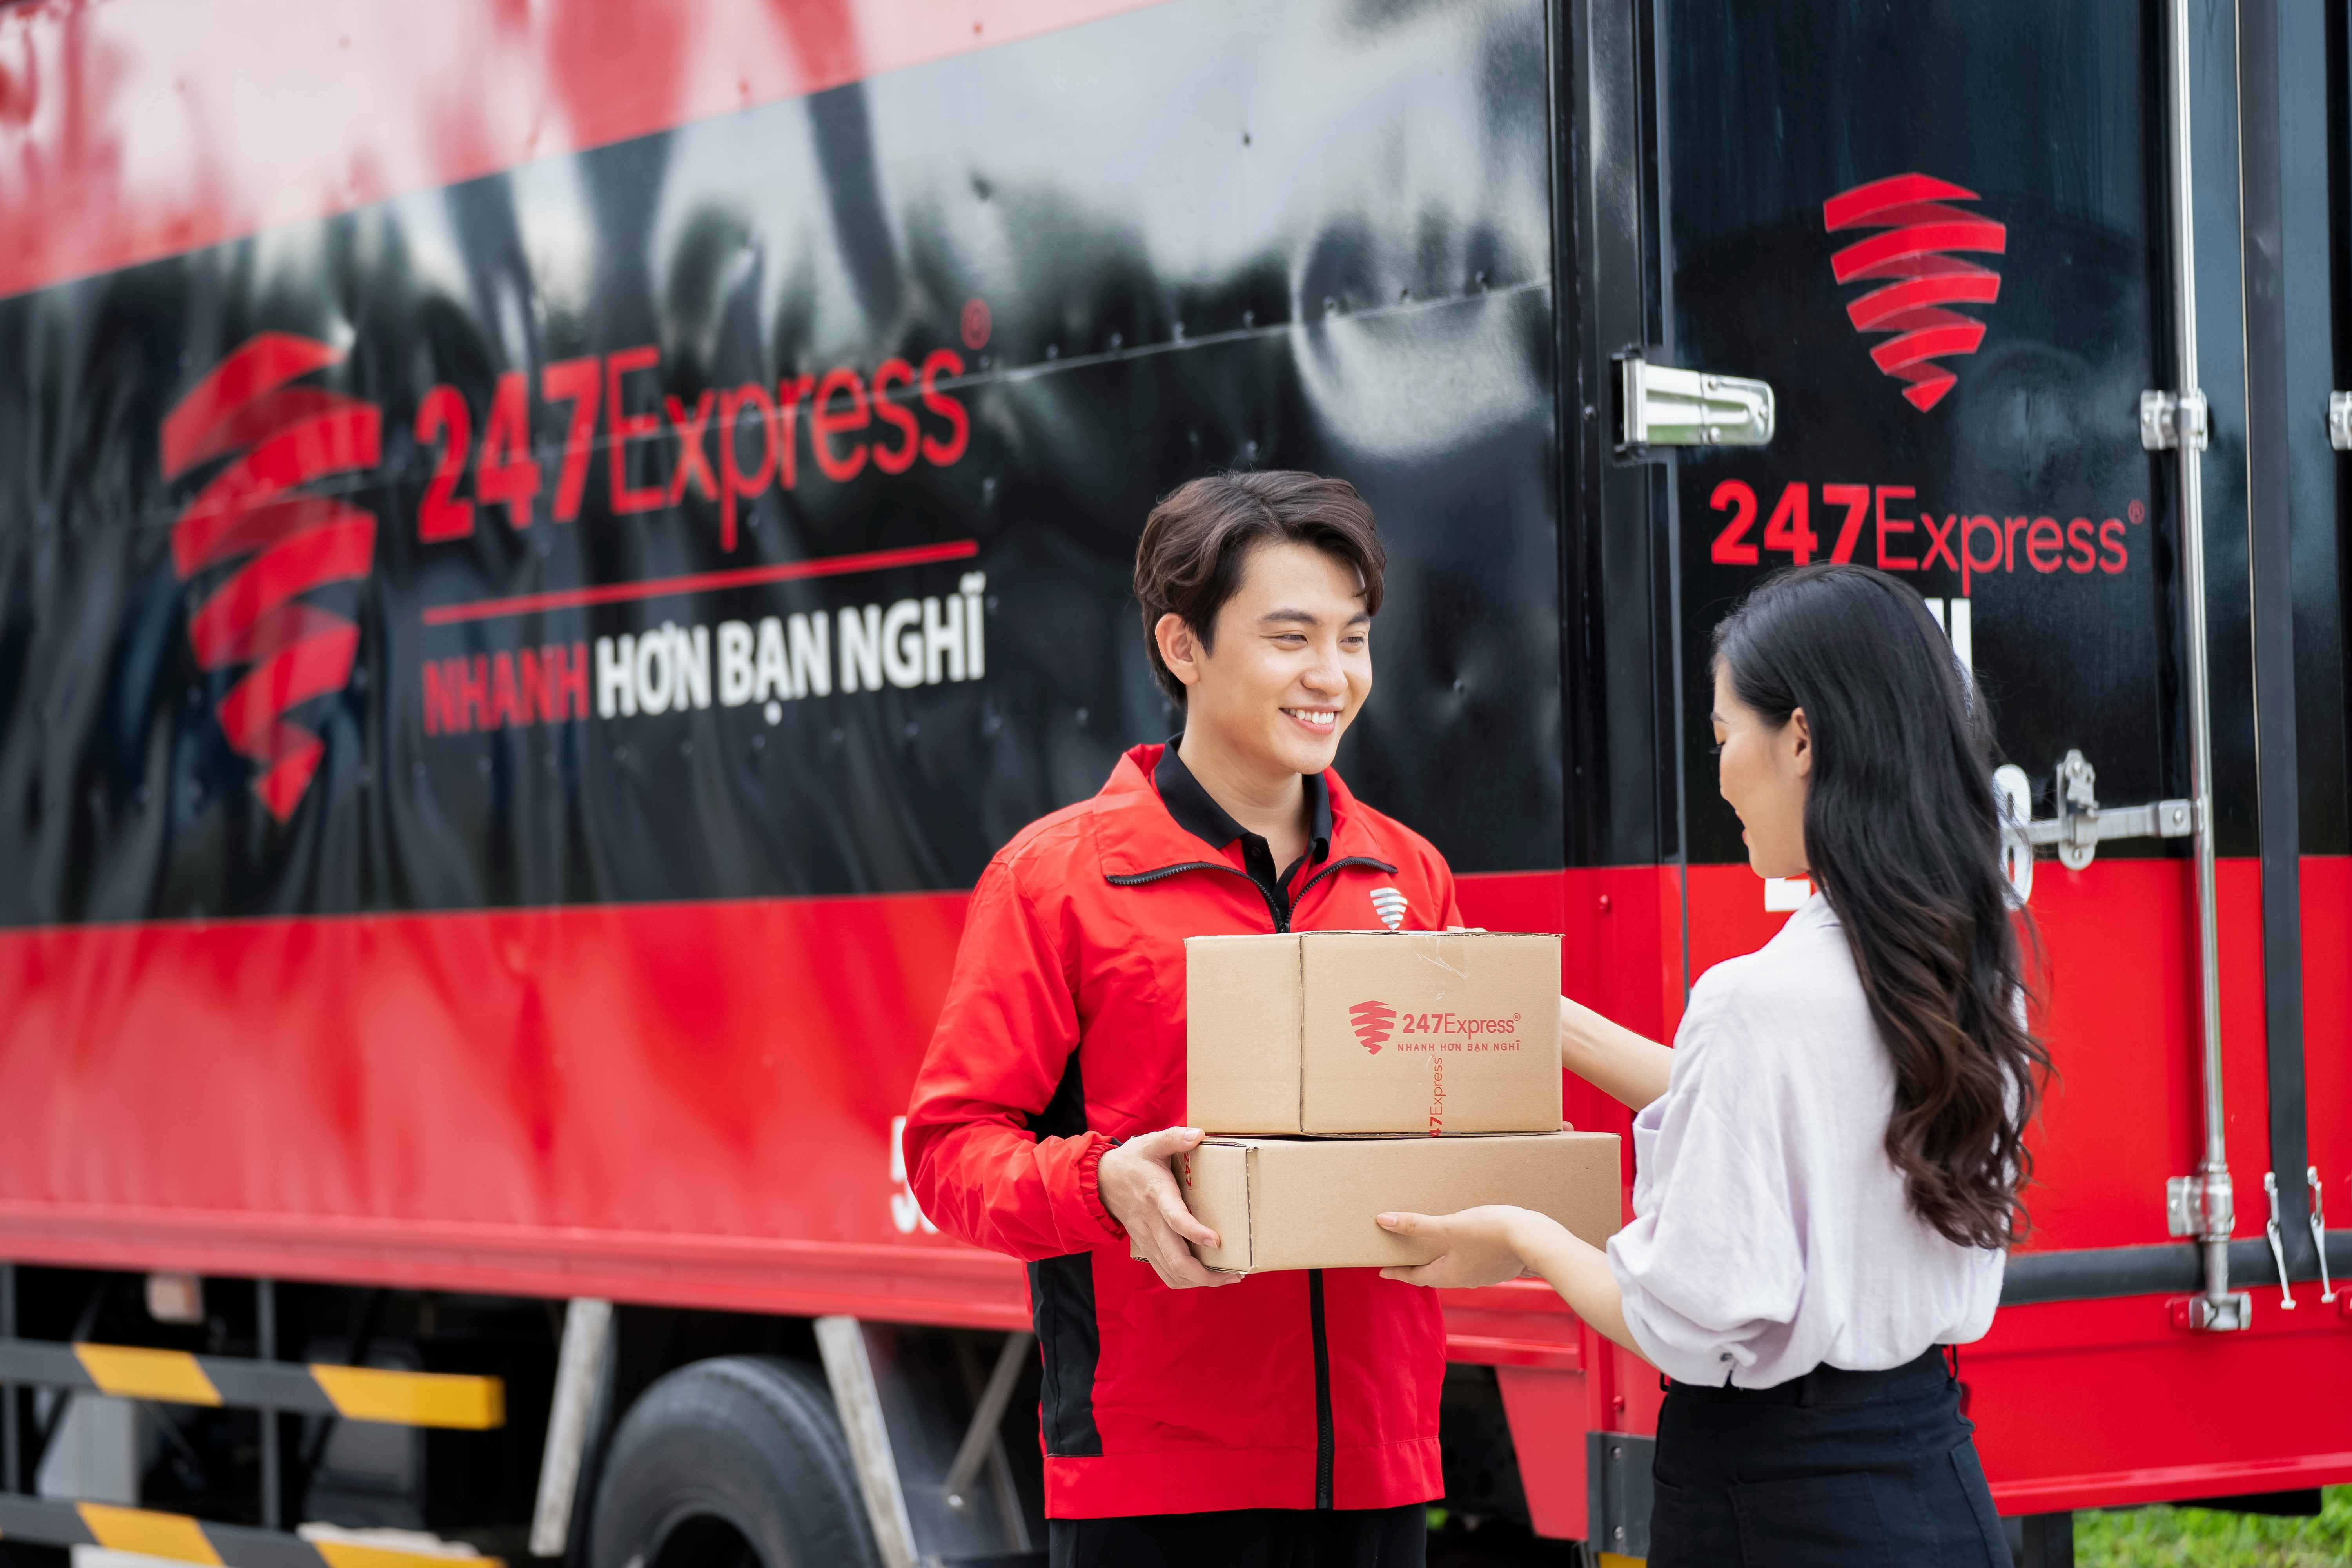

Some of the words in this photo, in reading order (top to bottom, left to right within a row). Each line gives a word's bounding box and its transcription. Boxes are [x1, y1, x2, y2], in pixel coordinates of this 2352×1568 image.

[422, 641, 590, 737] NHANH
[596, 619, 712, 720] HƠN
[717, 610, 832, 726] BẠN
[838, 570, 986, 695] NGHĨ
[1467, 1043, 1488, 1052] BẠN
[1429, 1058, 1446, 1138] 47Express
